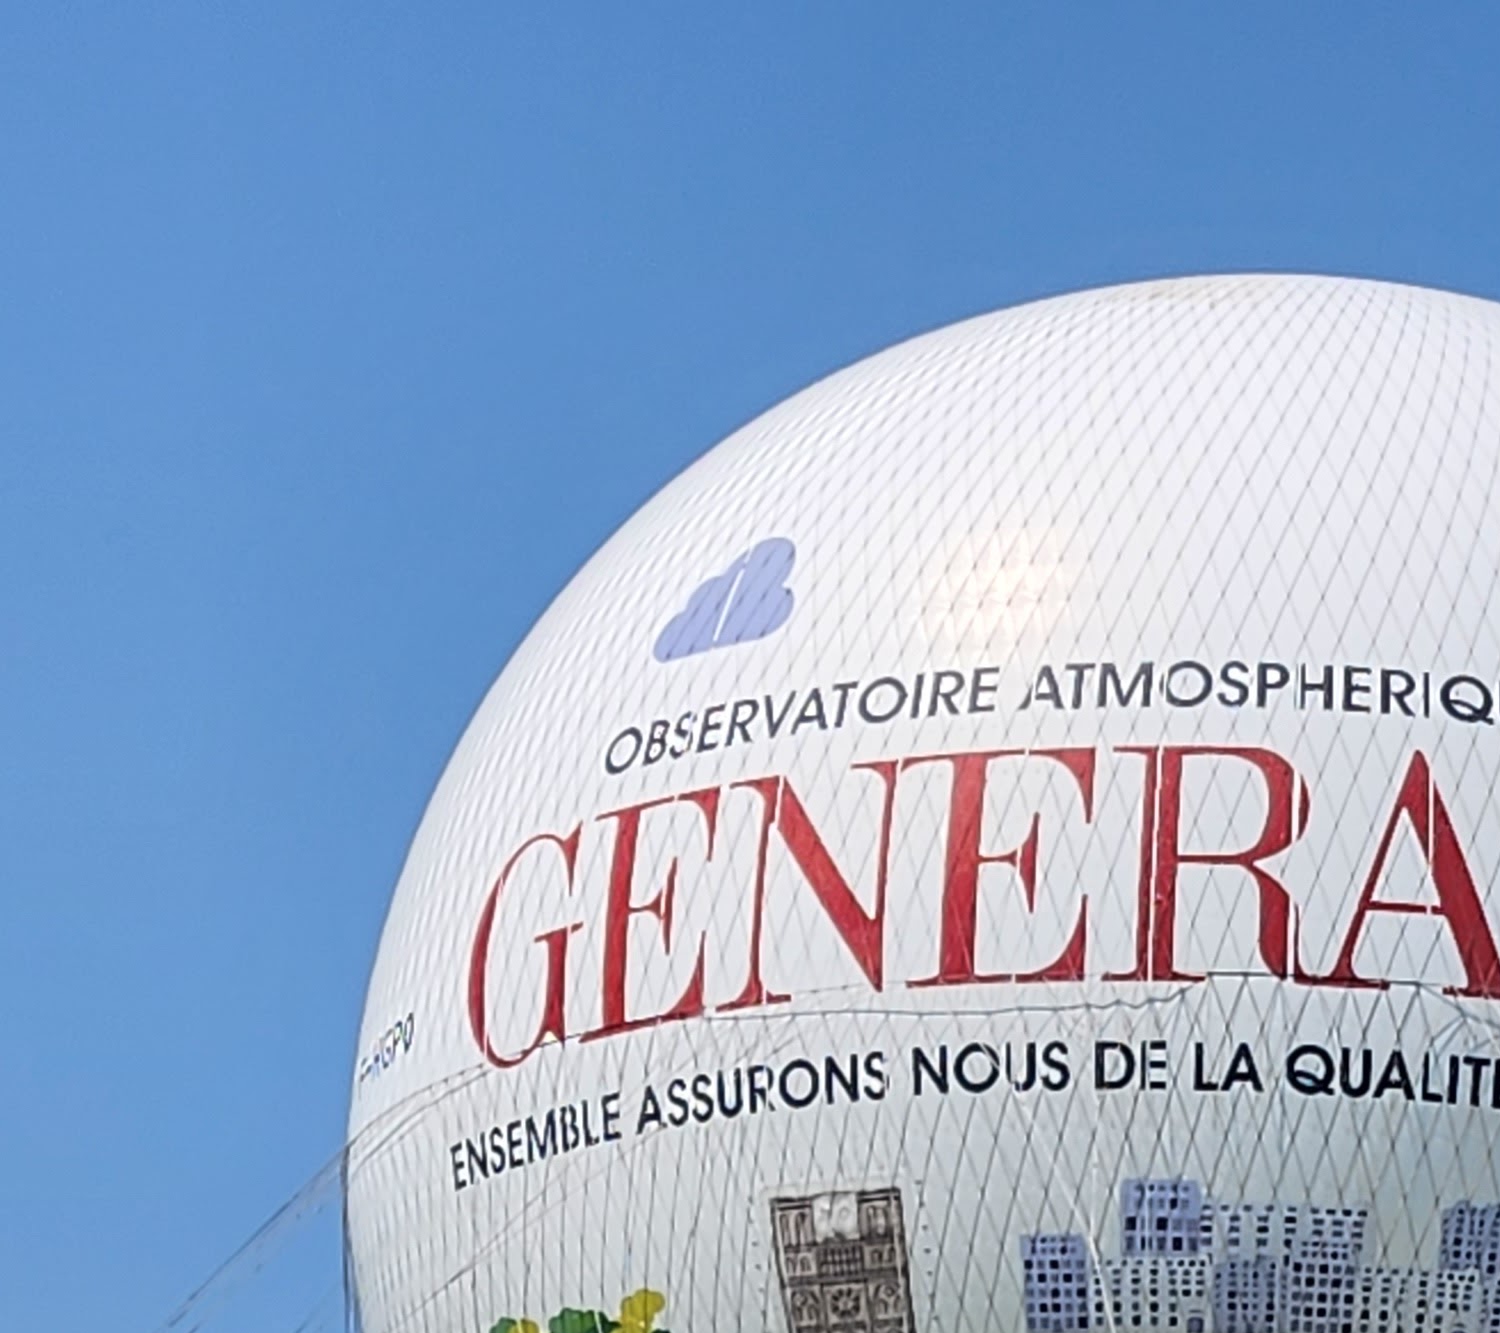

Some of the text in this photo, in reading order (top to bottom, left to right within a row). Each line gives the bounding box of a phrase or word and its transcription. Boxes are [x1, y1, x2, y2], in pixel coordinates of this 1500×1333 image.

[604, 666, 1000, 775] OBSERVATOIRE
[449, 1092, 622, 1192] ENSEMBLE
[636, 1050, 889, 1136] ASSURONS
[912, 1040, 1071, 1096] NOUS
[1094, 1040, 1168, 1090] DE
[1193, 1042, 1264, 1092] LA
